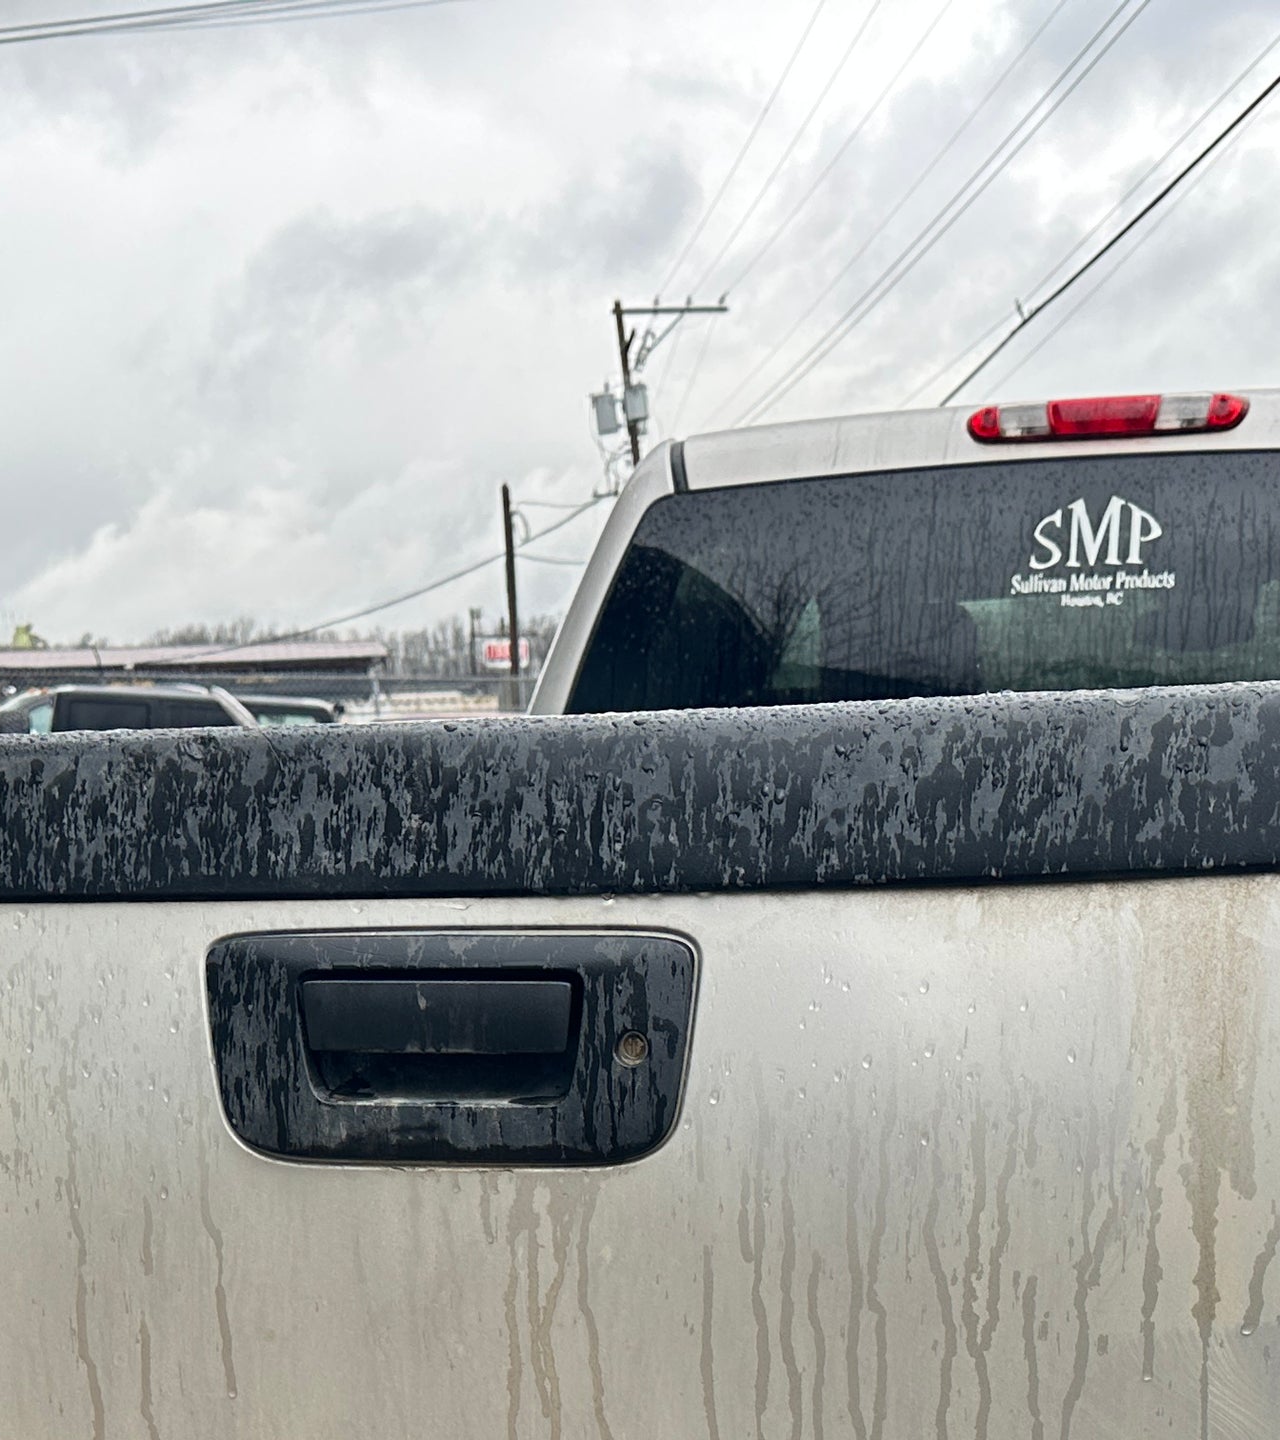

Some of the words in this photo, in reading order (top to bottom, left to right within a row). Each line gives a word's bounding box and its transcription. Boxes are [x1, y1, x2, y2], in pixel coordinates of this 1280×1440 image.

[1028, 494, 1163, 570] SMP
[1010, 573, 1067, 595] Sullivan
[1070, 572, 1113, 592] Motor
[1115, 568, 1176, 589] Products
